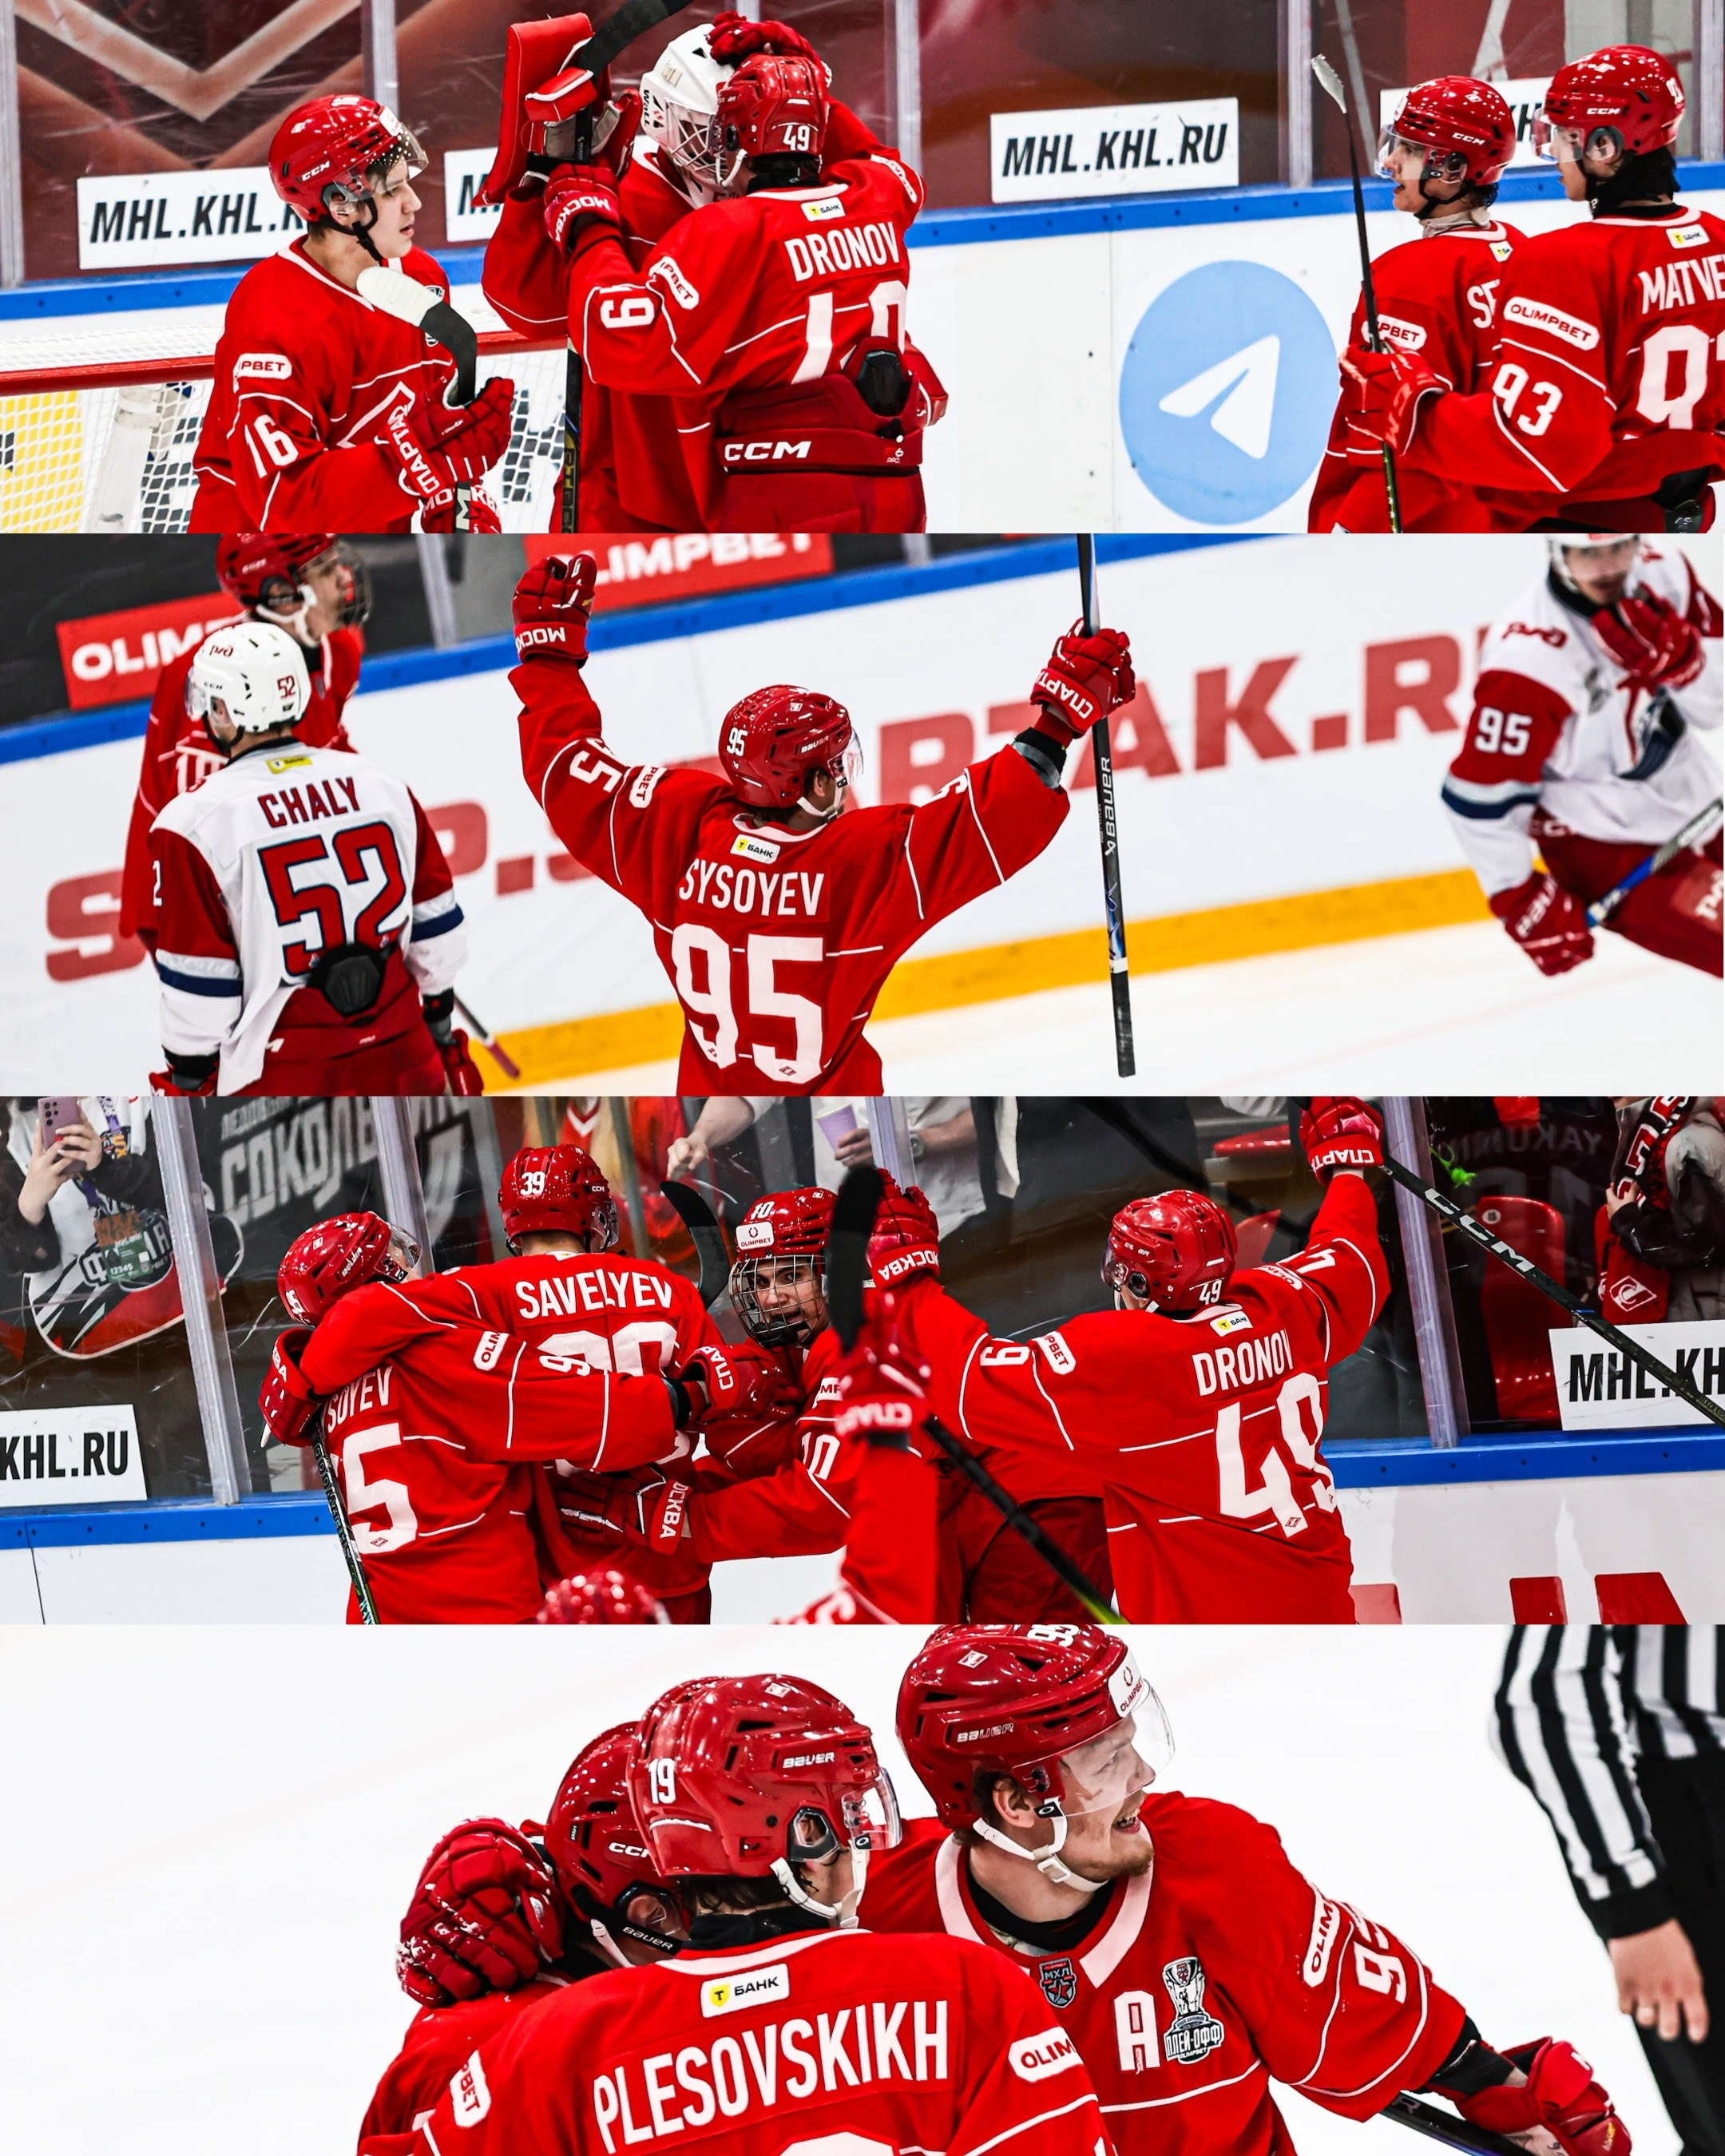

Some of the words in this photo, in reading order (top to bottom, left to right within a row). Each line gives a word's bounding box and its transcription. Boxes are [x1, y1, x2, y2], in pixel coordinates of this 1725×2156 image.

[783, 125, 810, 151] 49
[1002, 123, 1227, 177] MHL.KHL.RU
[1452, 133, 1485, 145] CCM
[301, 161, 330, 181] CCM
[89, 194, 306, 243] MHL.KHL.
[783, 221, 900, 282] DRONOV
[661, 261, 694, 301] PBET
[1379, 323, 1420, 343] PBET
[1509, 303, 1592, 343] OLIMPBET
[240, 360, 285, 373] PBET
[1493, 363, 1563, 437] 93
[244, 414, 299, 479] 16
[724, 440, 812, 462] CCM
[422, 485, 502, 518] МОКВ
[72, 617, 232, 681] OLIM
[515, 627, 566, 652] МОСК
[277, 675, 296, 699] 52
[1037, 671, 1094, 719] СПАРТ
[726, 727, 748, 756] 95
[1474, 705, 1533, 756] 95
[636, 767, 659, 801] PBET
[257, 775, 361, 829] CHALY
[748, 842, 774, 859] БАНК
[257, 820, 406, 977] 52
[679, 858, 824, 916] SYSOYEV
[672, 922, 824, 1084] 95
[1312, 1148, 1374, 1171] СПАРТ
[520, 1171, 545, 1195] 39
[750, 1201, 775, 1220] 10
[740, 1237, 771, 1247] OLIMPBET
[1425, 1187, 1536, 1273] CCM
[515, 1268, 672, 1320] SAVELYEV
[1199, 1279, 1223, 1305] 49
[480, 1331, 502, 1364] OLIM
[1045, 1335, 1069, 1366] PBET
[1192, 1328, 1294, 1397] DRONOV
[698, 1346, 735, 1391] СПАР
[327, 1365, 393, 1435] SOYEV
[1215, 1373, 1337, 1539] 49
[339, 1423, 420, 1555] 5
[957, 1722, 1013, 1743] BAUER
[782, 1752, 835, 1770] BAUER
[648, 1758, 676, 1805] 19
[623, 1926, 673, 1950] BAUER
[1310, 1900, 1334, 1975] OLIM
[734, 1976, 779, 1998] БАНК
[1045, 1967, 1070, 1980] МХЛ
[1115, 1991, 1160, 2073] A
[1165, 2024, 1221, 2057] ПЛЕЙ-ОФФ
[1021, 2039, 1074, 2070] OLIM
[593, 2000, 950, 2154] PLESOVSKIKH
